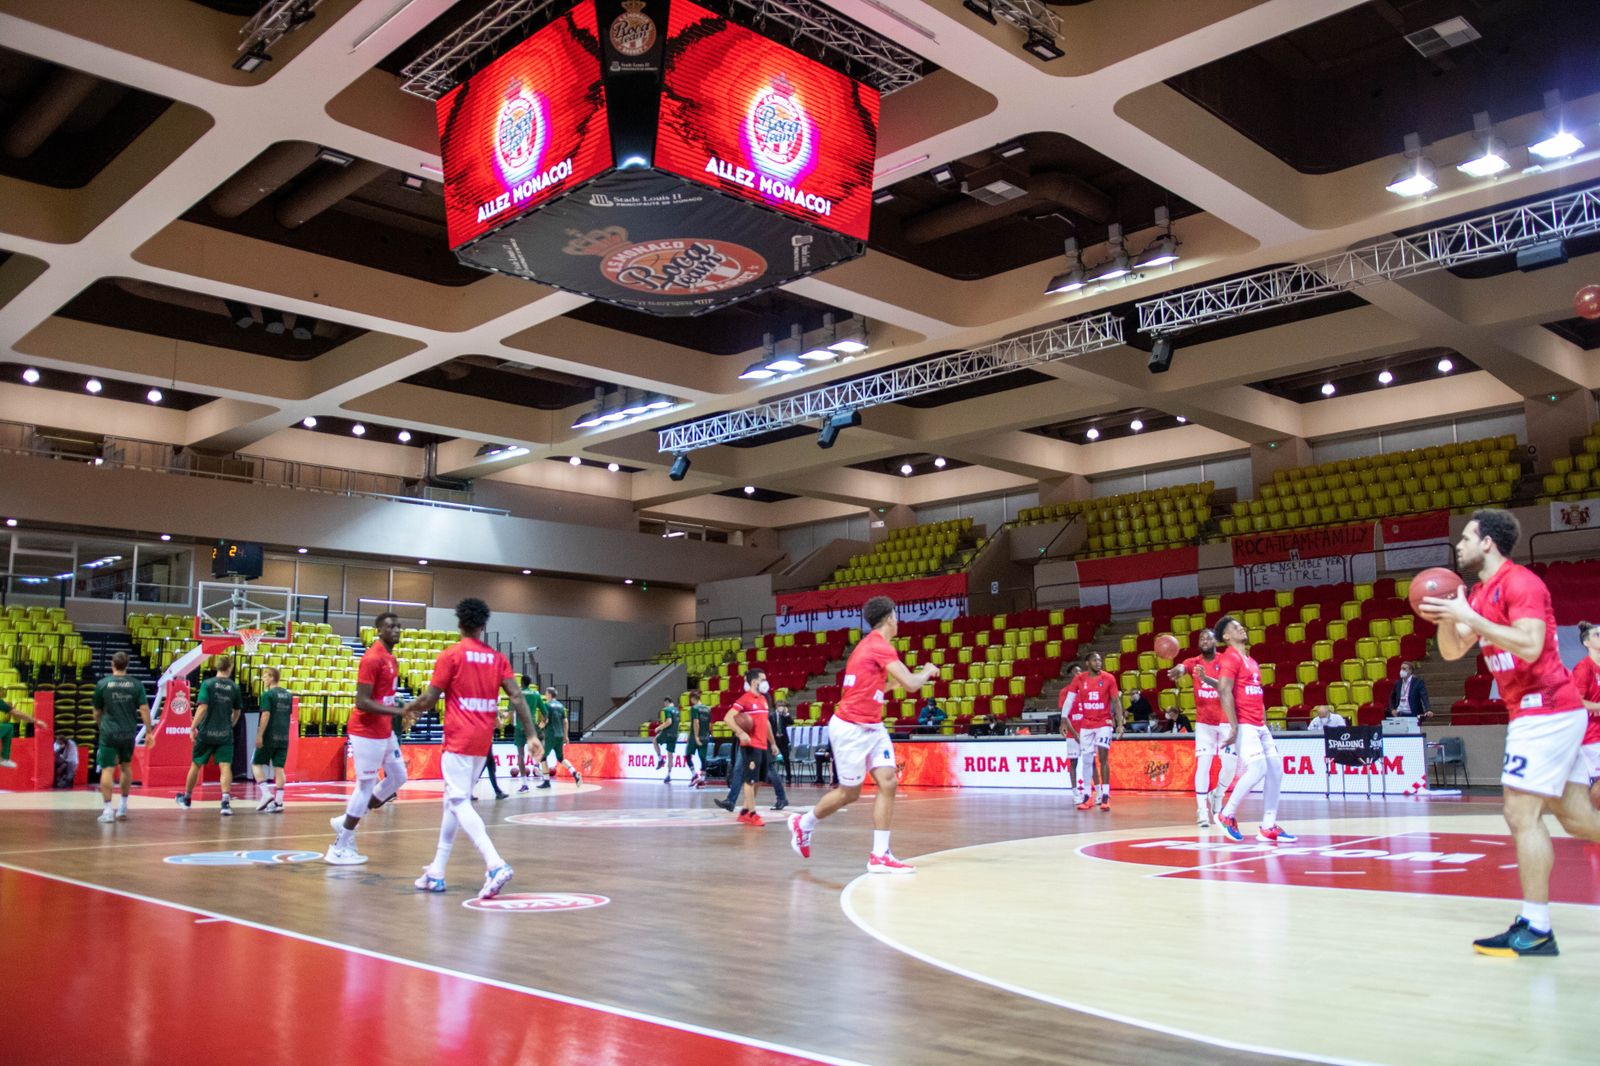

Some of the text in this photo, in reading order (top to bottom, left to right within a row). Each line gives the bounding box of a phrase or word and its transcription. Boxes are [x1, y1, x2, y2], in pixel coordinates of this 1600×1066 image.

[477, 158, 573, 223] ALLEZ MONACO!
[704, 156, 832, 216] ALLEZ MONACO!
[617, 241, 715, 291] Roca
[1253, 573, 1271, 587] LE
[1278, 569, 1322, 582] TITRE
[1088, 691, 1100, 700] 15
[1328, 739, 1365, 749] SPALDING
[628, 754, 655, 767] ROCA
[964, 756, 1072, 773] ROCA TEAM
